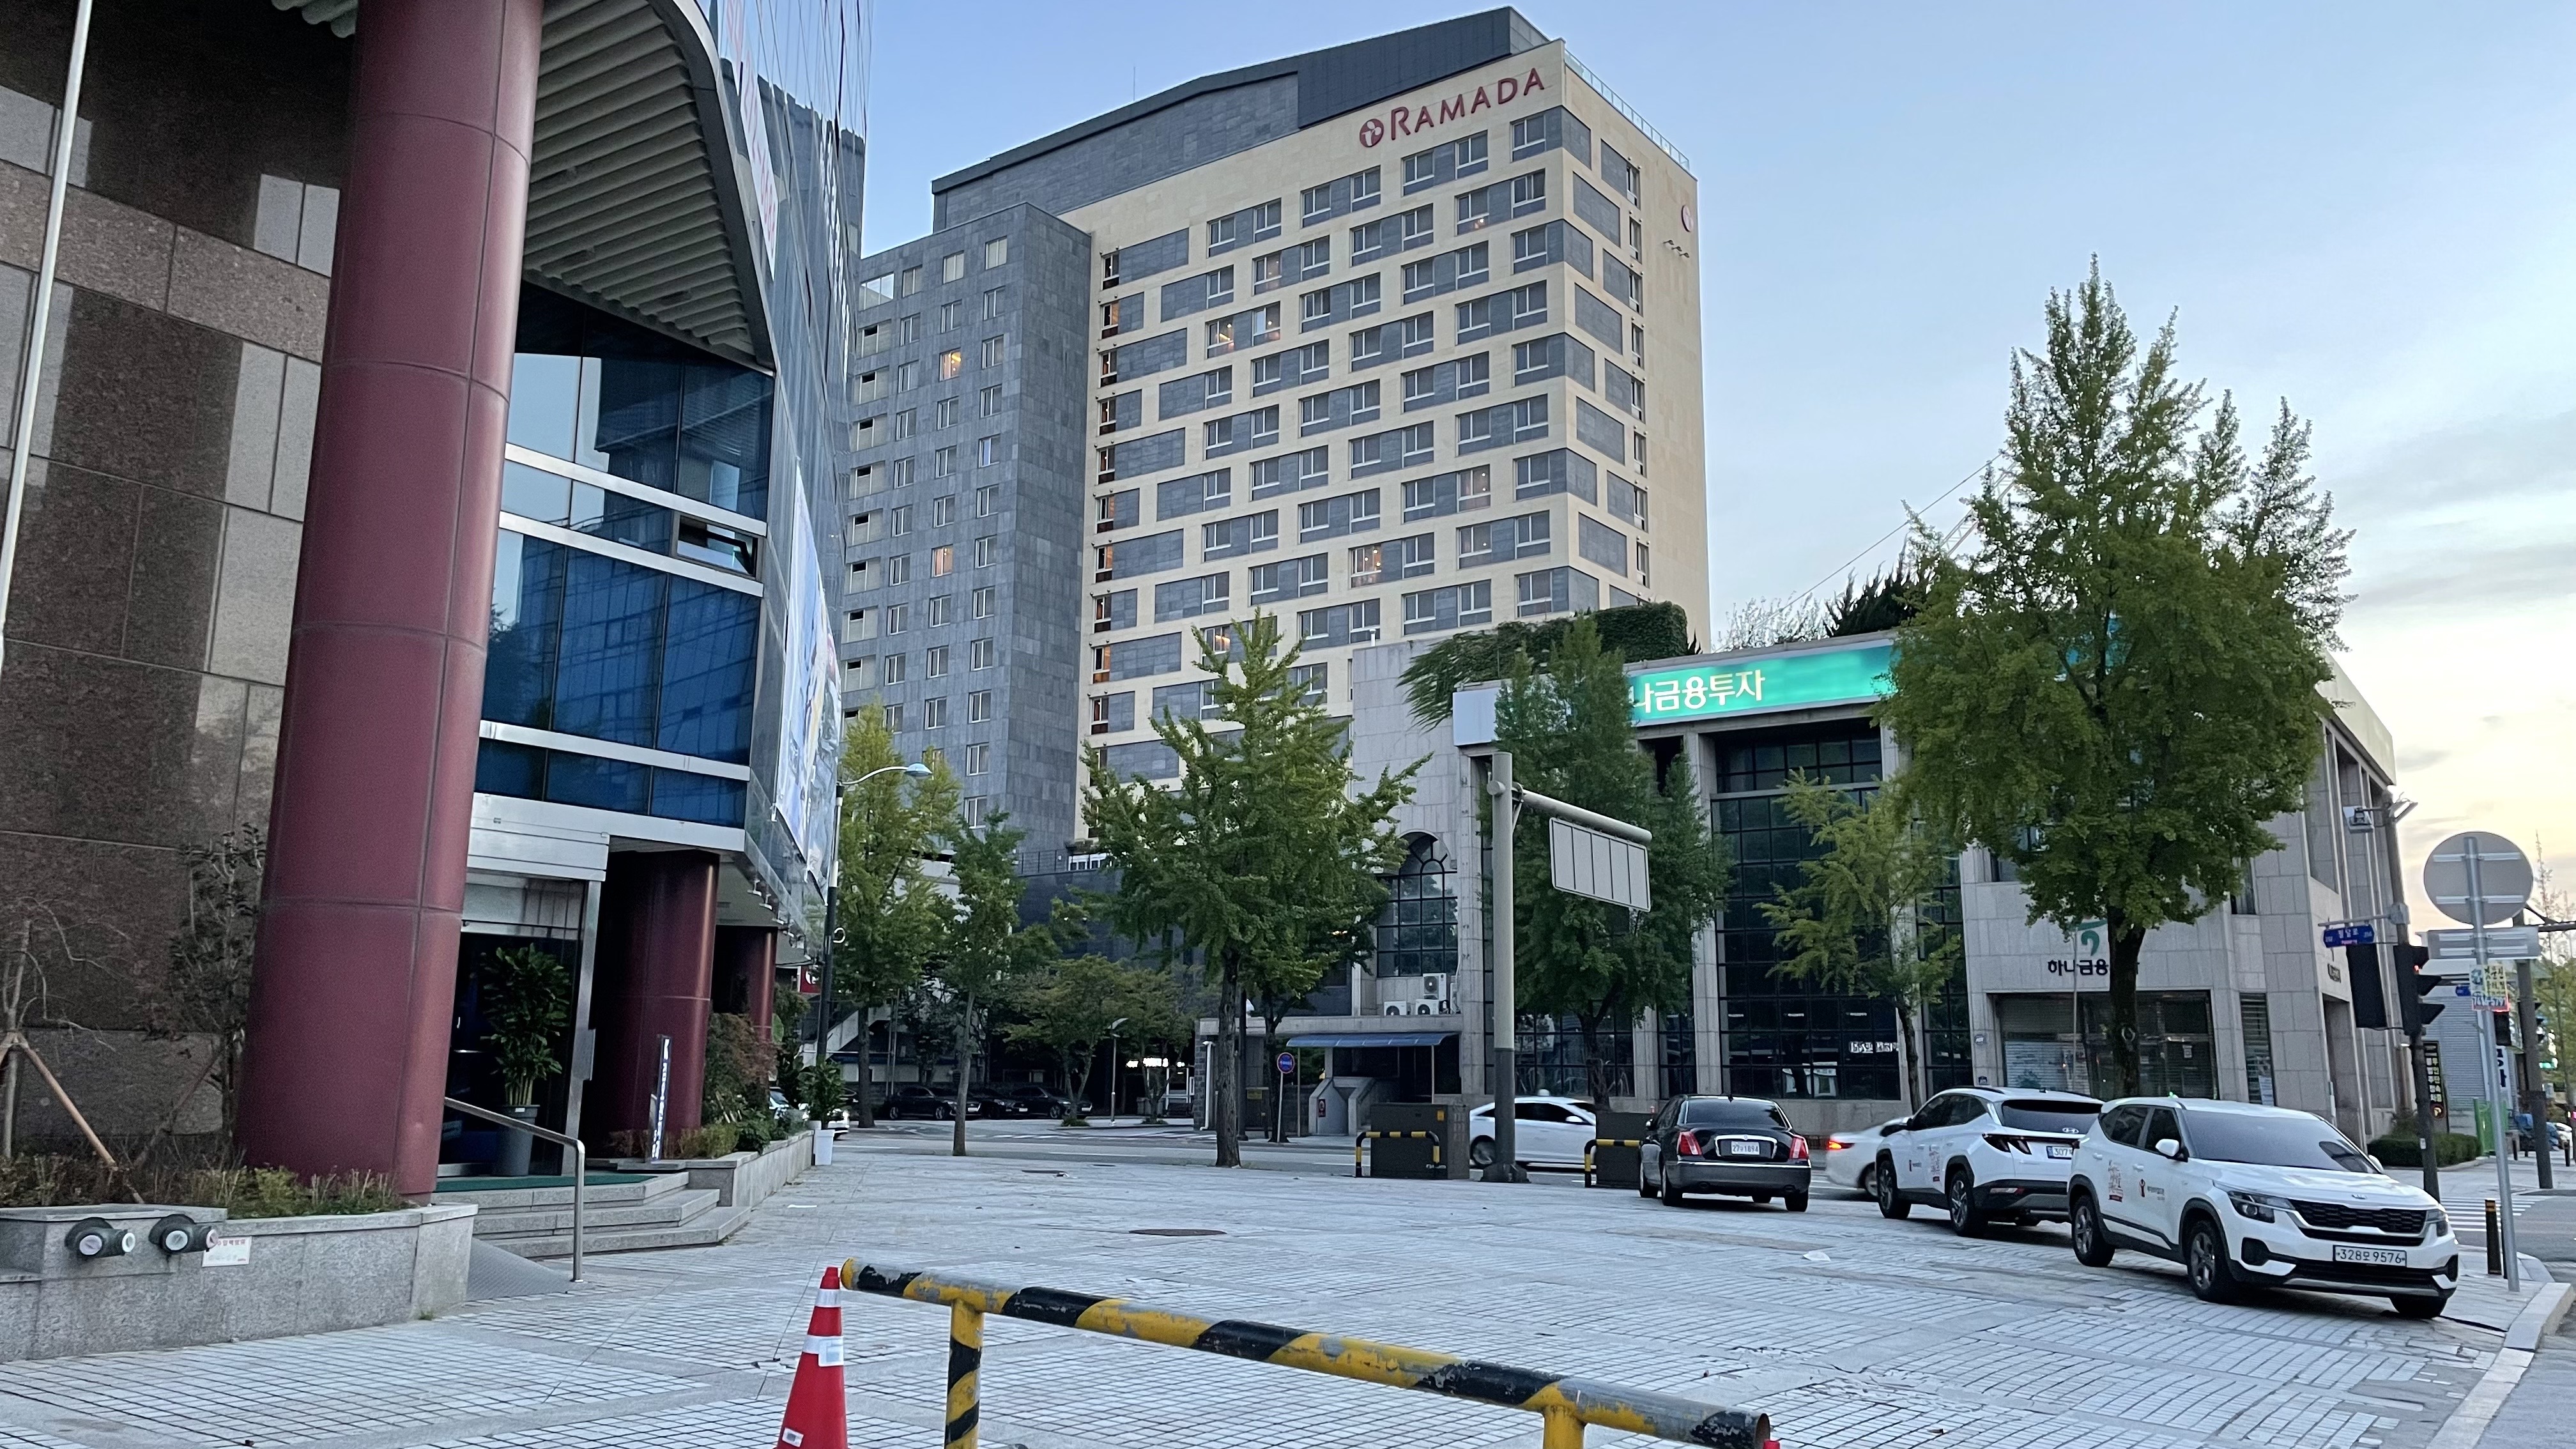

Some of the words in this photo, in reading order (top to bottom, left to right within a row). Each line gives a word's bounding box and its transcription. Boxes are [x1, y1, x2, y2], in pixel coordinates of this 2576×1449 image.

[1391, 68, 1545, 141] RAMADA
[1629, 670, 1766, 714] 나금융투자
[2048, 958, 2140, 976] 하나금융
